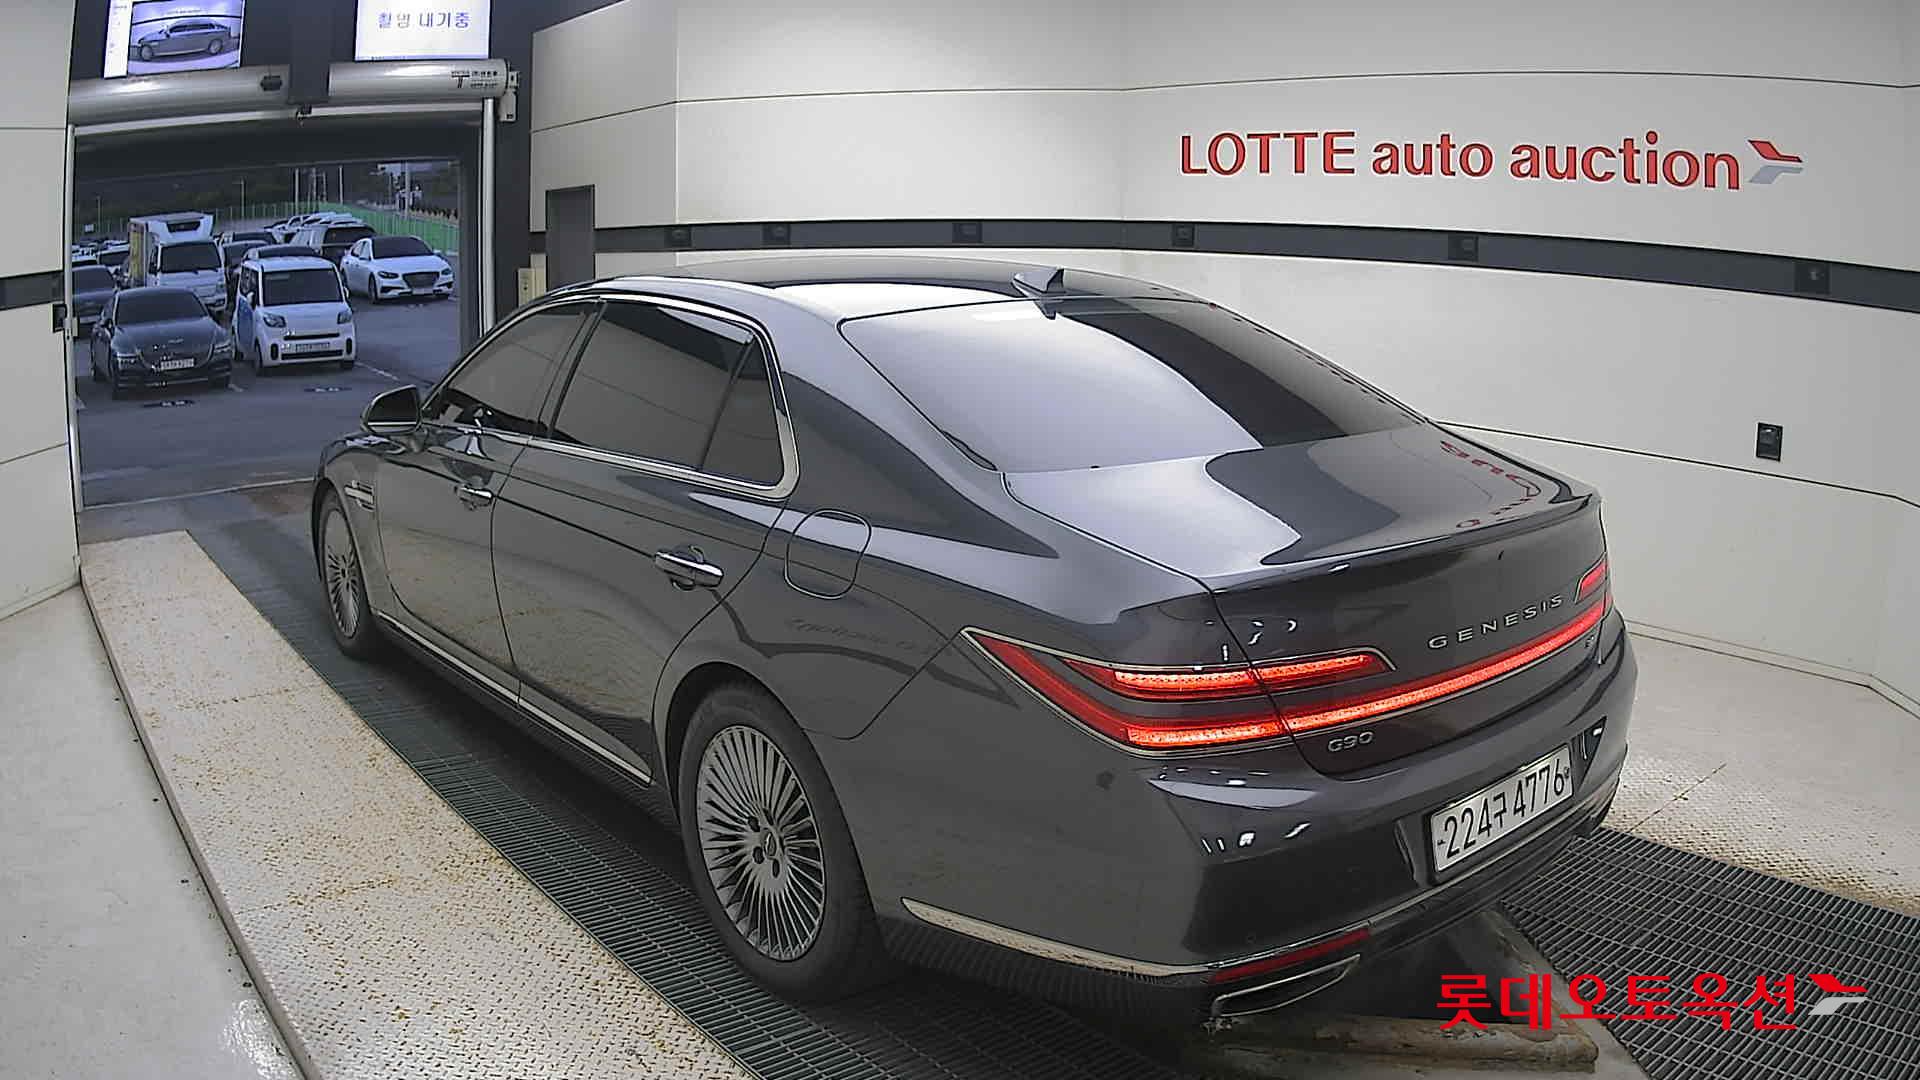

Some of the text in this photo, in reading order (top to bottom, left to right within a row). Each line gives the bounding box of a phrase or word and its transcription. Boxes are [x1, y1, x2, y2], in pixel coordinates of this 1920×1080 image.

[1181, 131, 1742, 189] LOTTE auto auction
[1428, 594, 1565, 650] GENESIS
[1328, 731, 1374, 753] G90
[1512, 758, 1566, 818] 4776
